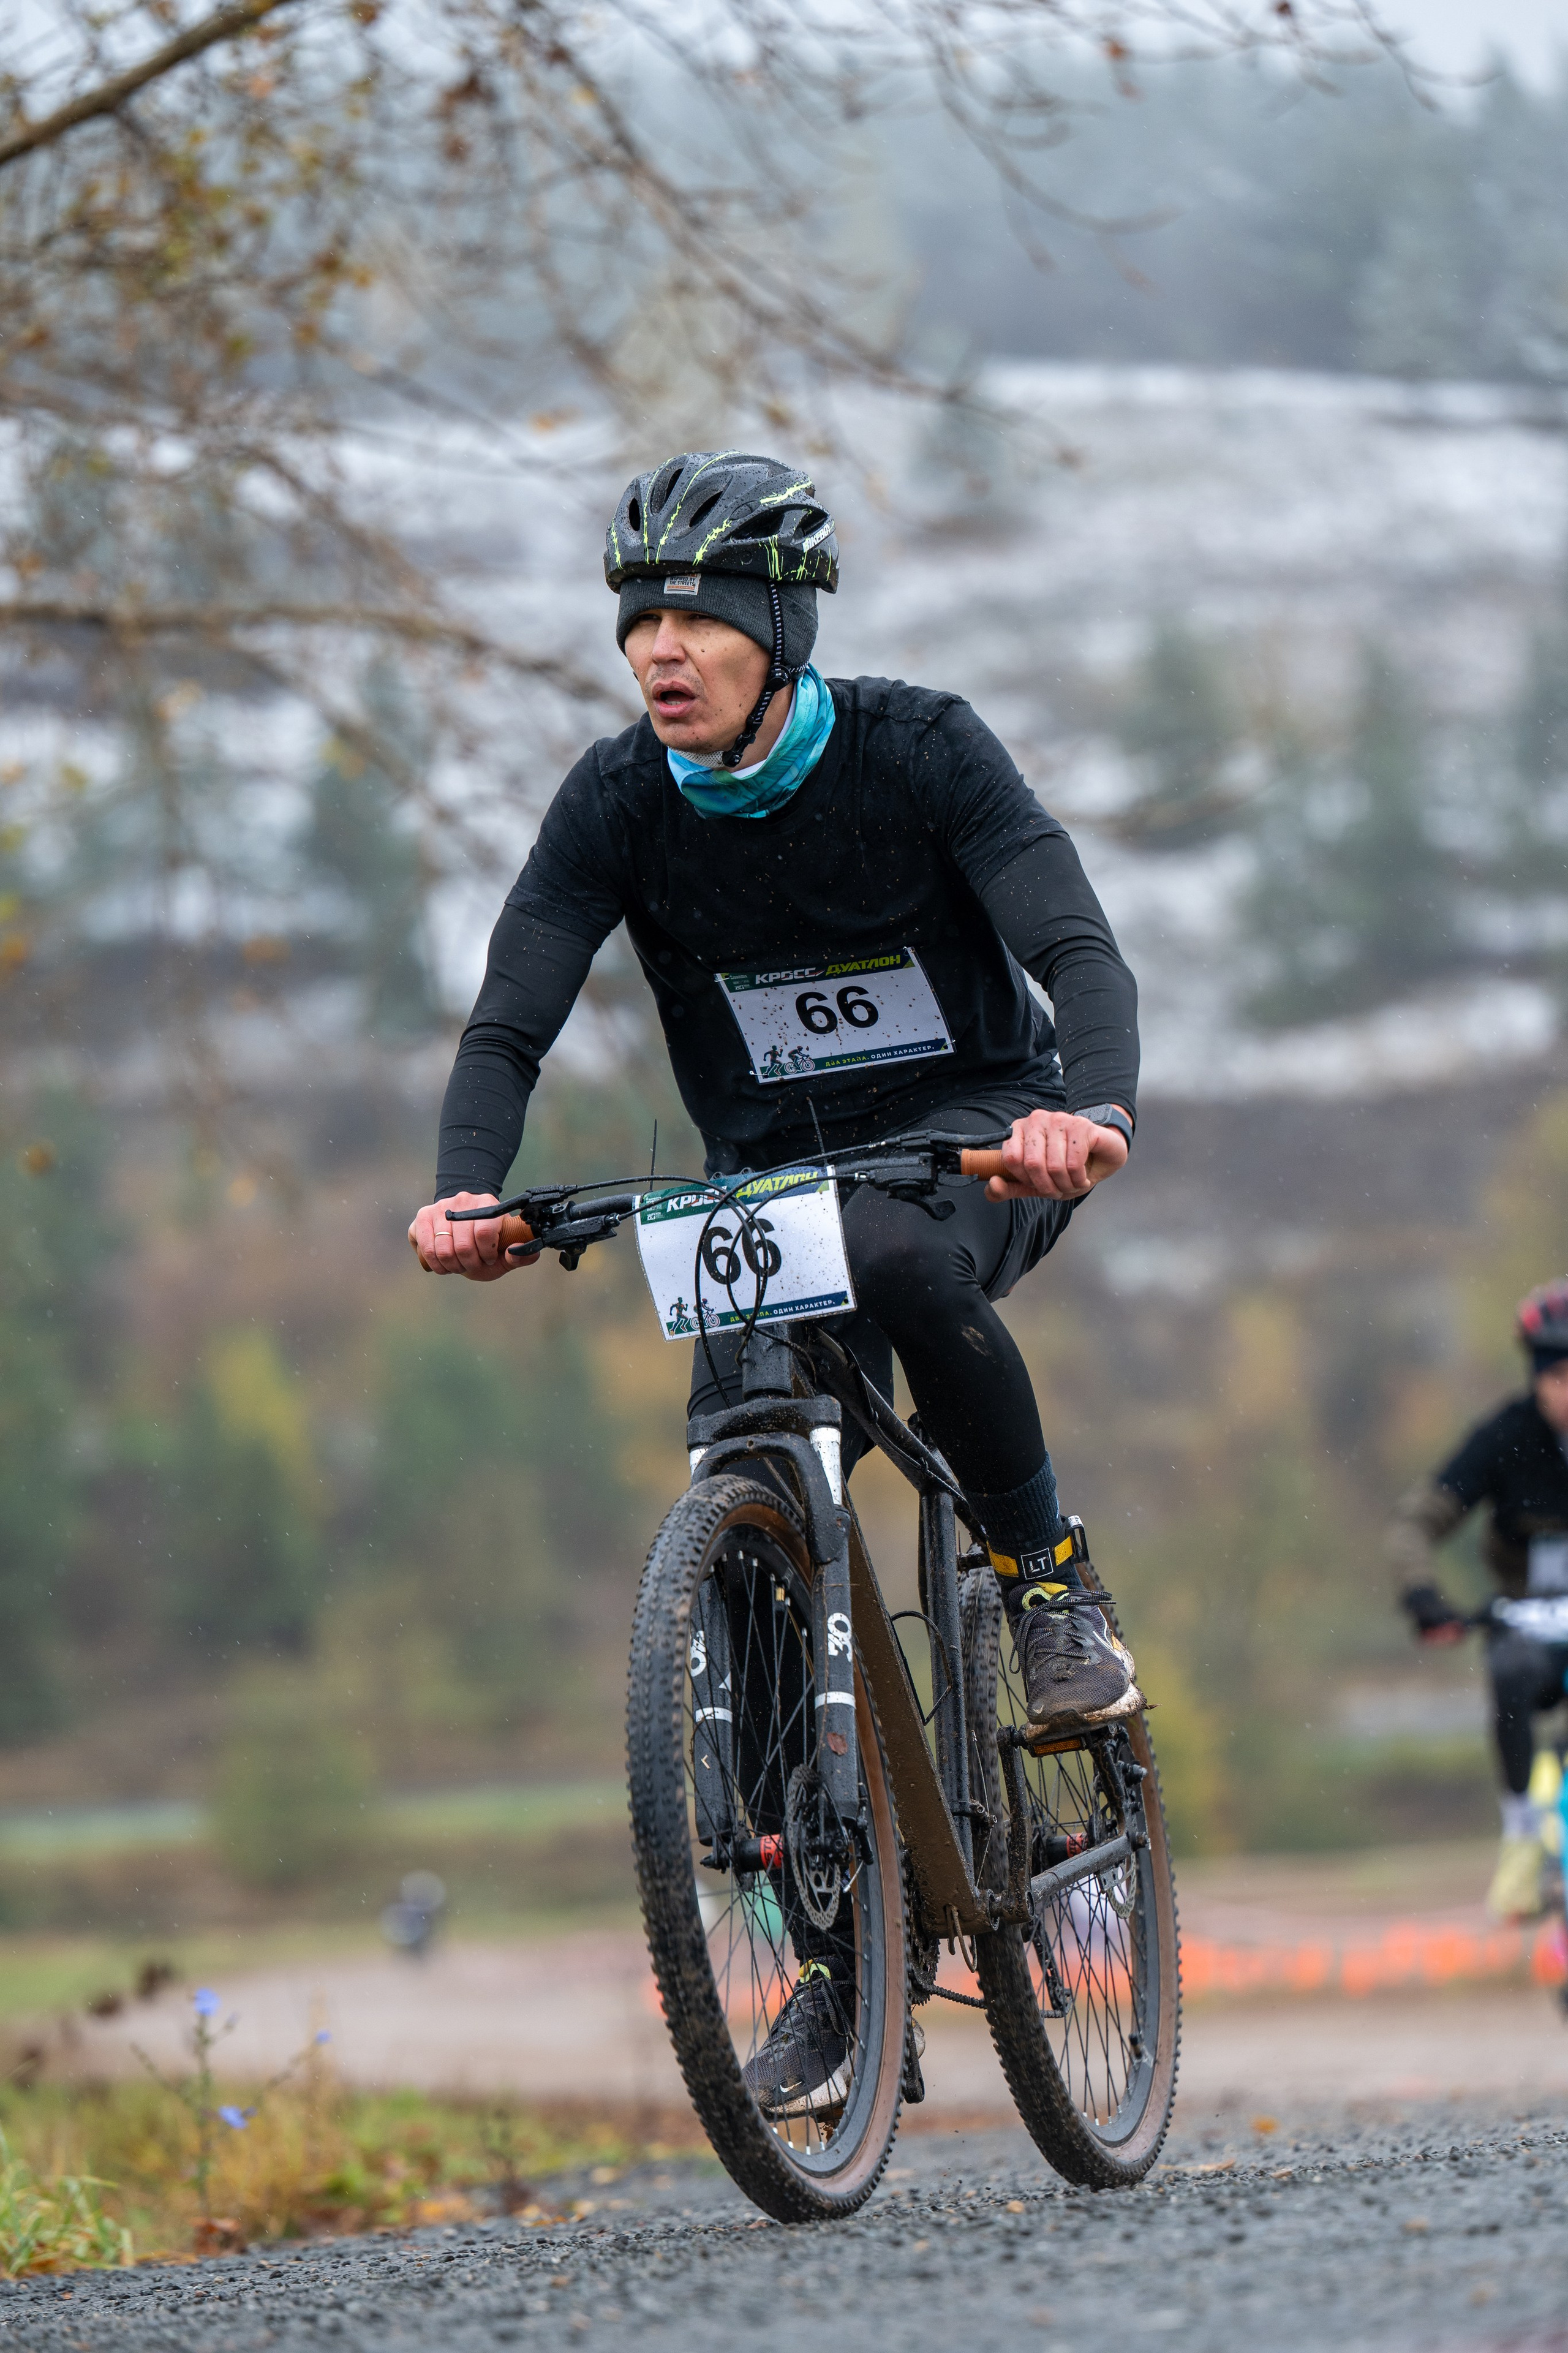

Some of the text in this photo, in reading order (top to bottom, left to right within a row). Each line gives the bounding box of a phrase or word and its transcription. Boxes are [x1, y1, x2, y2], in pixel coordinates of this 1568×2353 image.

[825, 954, 900, 976] ДУАТЛОН
[795, 986, 879, 1035] 66
[893, 1045, 935, 1056] ХАРАКТЕР.
[701, 1218, 782, 1285] 66
[794, 1300, 835, 1311] ХАРАКТЕР.
[1029, 1557, 1046, 1573] LT
